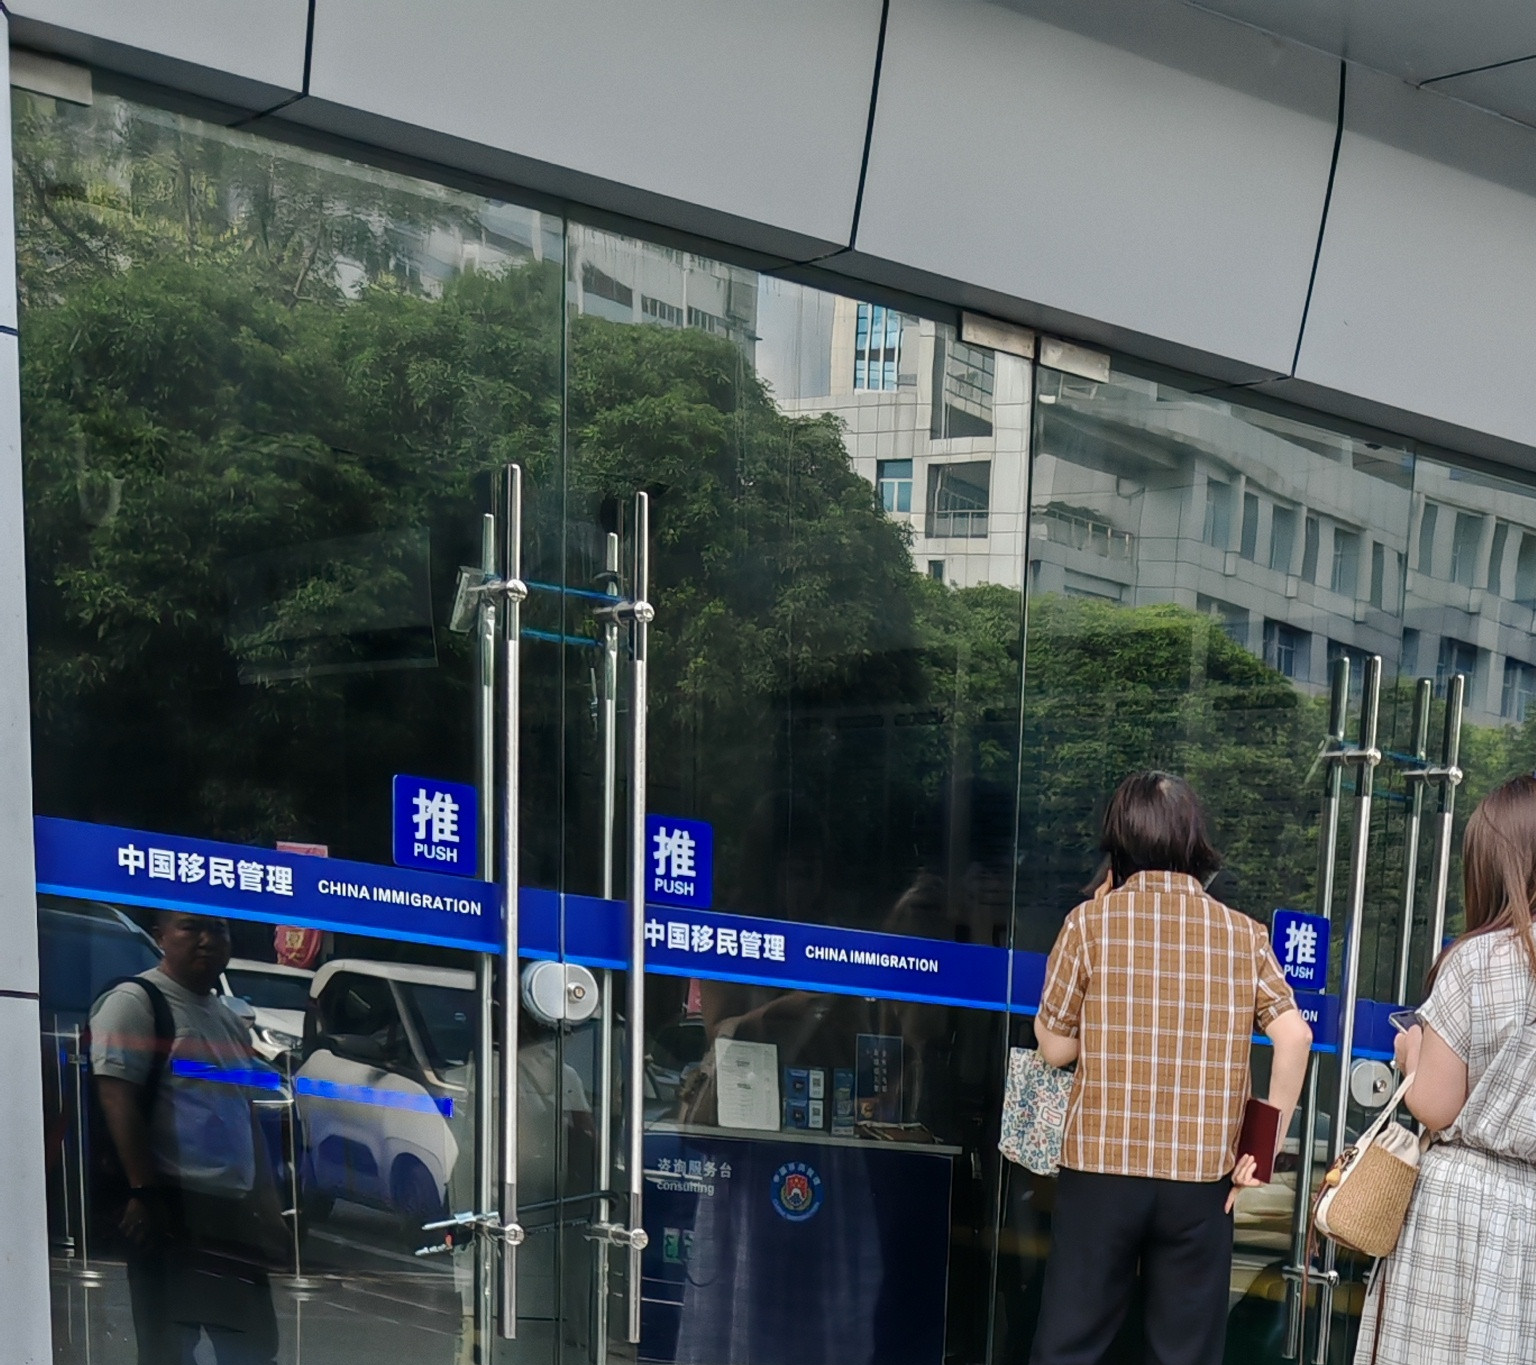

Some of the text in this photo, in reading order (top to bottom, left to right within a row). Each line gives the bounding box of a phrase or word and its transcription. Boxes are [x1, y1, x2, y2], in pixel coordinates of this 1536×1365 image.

[412, 788, 460, 843] 推
[414, 842, 458, 863] PUSH
[653, 826, 696, 877] 推
[118, 844, 482, 916] 中国移民管理 CHINA IMMIGRATION
[654, 877, 695, 897] PUSH
[644, 918, 939, 973] 中国移民管理 CHINA IMMIGRATION
[1285, 921, 1317, 964] 推
[1284, 964, 1314, 980] PUSH
[658, 1158, 732, 1178] 咨询服务台
